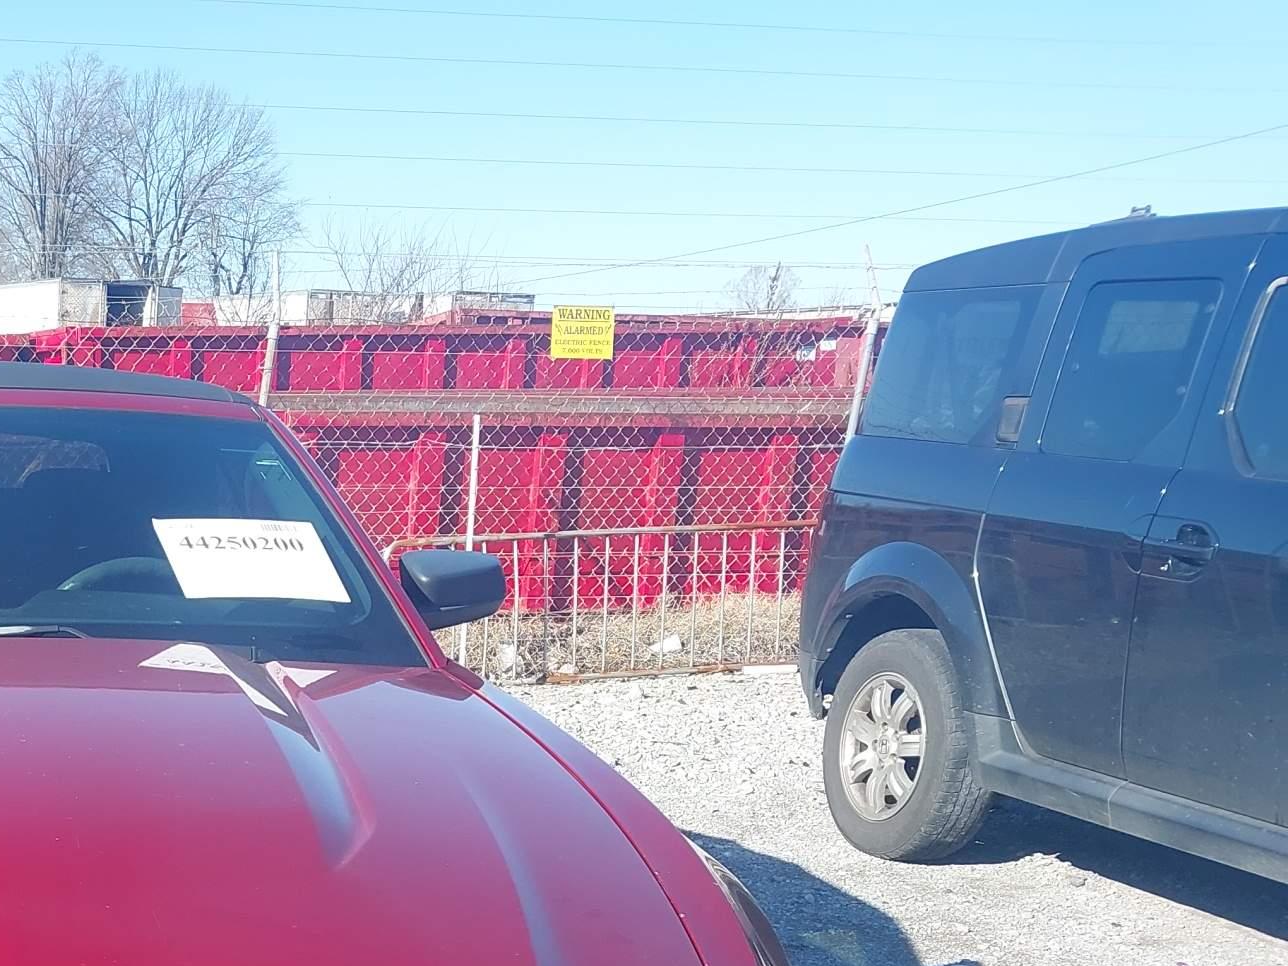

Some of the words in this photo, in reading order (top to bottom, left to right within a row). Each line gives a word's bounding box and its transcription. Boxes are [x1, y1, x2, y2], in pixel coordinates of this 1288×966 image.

[558, 308, 610, 320] WARNING
[563, 325, 604, 335] ALARMED
[179, 535, 304, 552] 44250200
